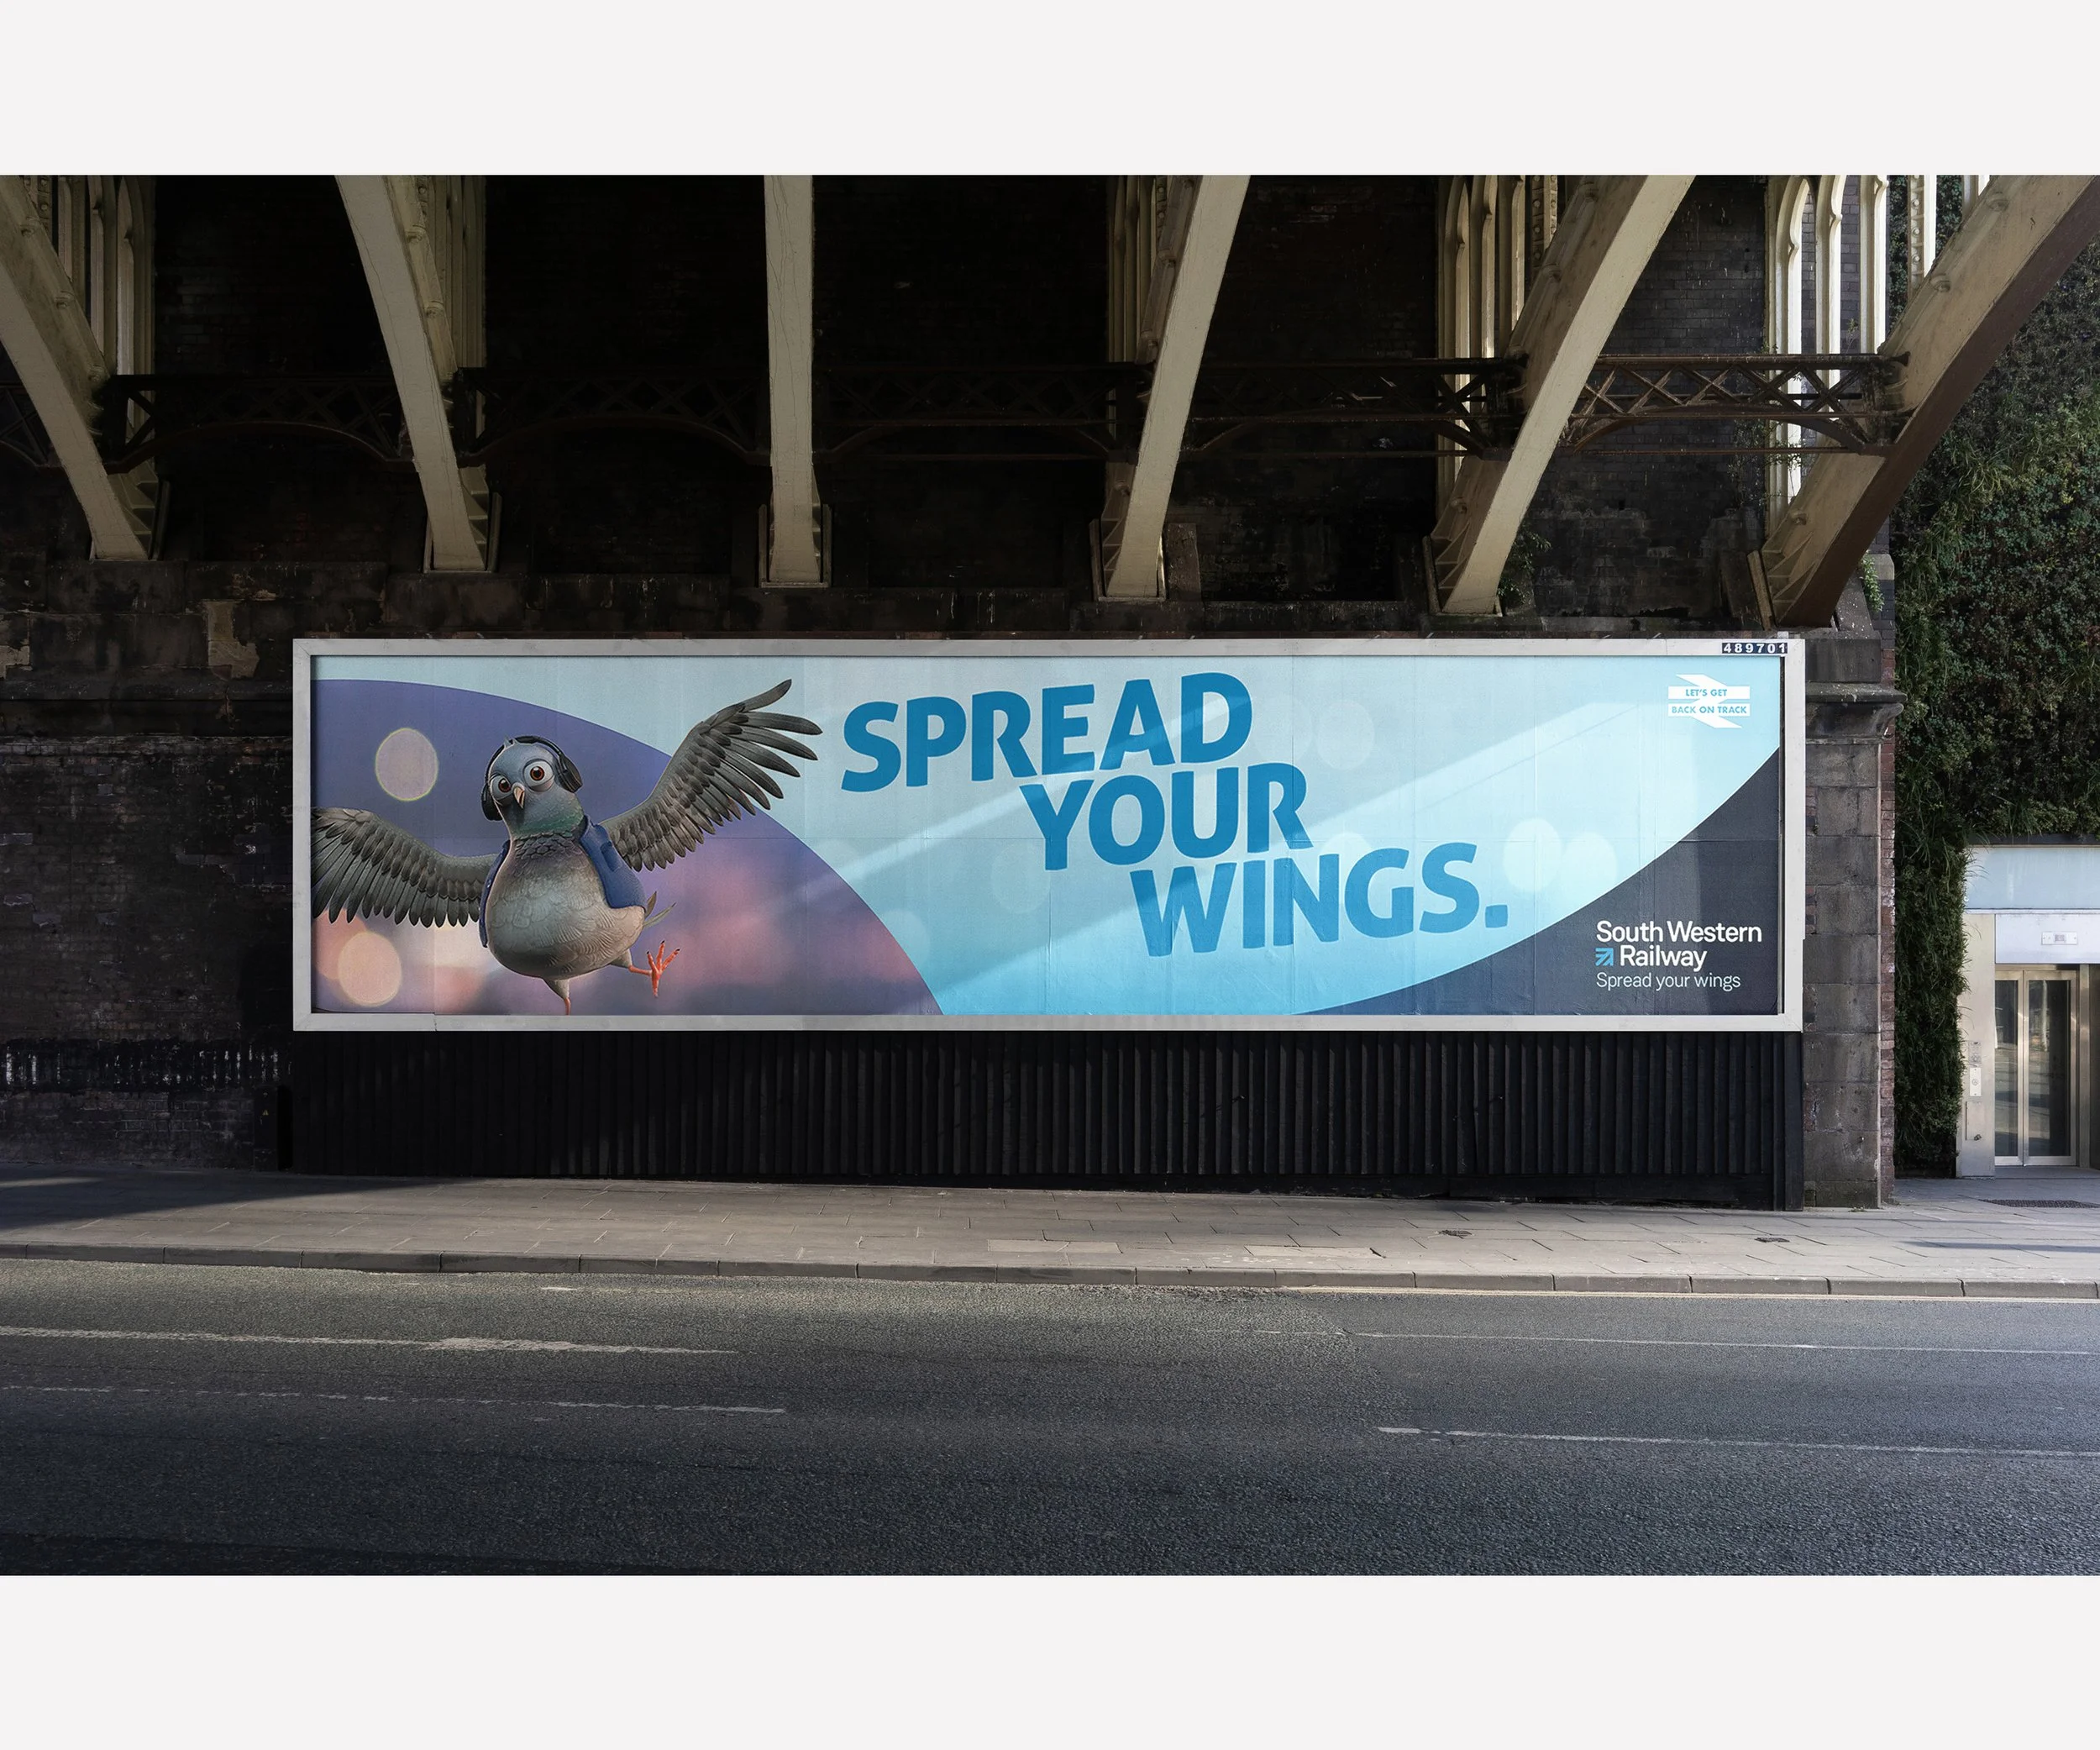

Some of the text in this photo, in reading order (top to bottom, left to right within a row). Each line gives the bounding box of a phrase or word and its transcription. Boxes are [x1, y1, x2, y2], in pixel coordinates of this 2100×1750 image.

[1724, 643, 1787, 654] 489701
[841, 672, 1252, 793] SPREAD
[1019, 763, 1314, 871] YOUR
[1130, 842, 1509, 957] WINGS.
[1596, 920, 1762, 942] South Western
[1620, 944, 1708, 972] Railway
[1596, 972, 1741, 991] Spread your wings
